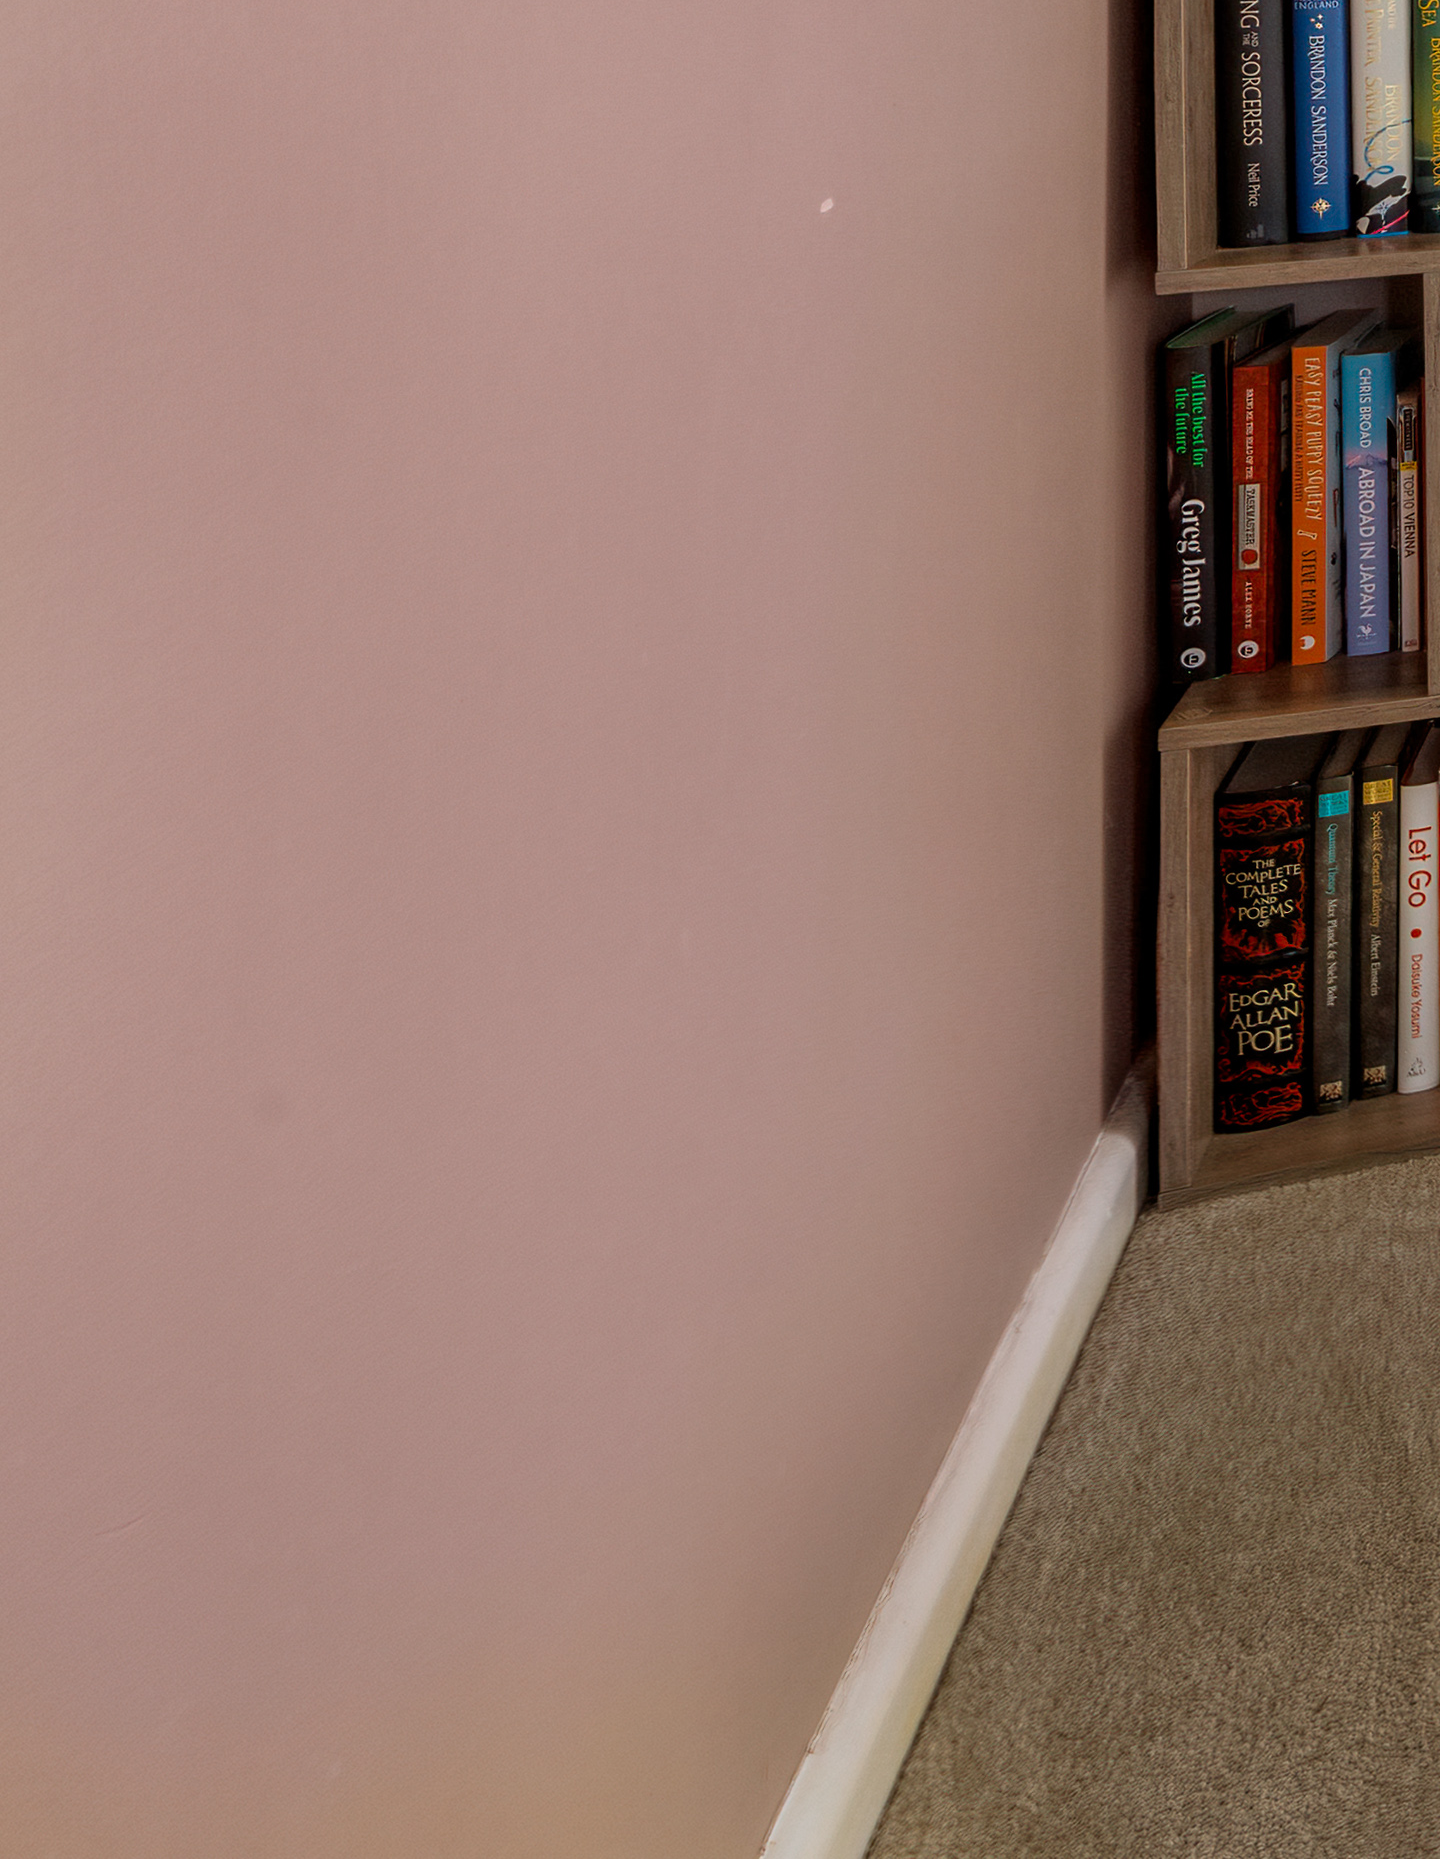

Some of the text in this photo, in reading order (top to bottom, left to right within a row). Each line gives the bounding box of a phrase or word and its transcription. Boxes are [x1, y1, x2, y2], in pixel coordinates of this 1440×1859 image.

[1308, 35, 1329, 186] BRANDON SANDERSON
[1247, 162, 1260, 207] Neil Price
[1174, 387, 1191, 454] the future
[1359, 367, 1372, 449] CHRIS BROAD
[1304, 357, 1325, 521] EASY PEASY PUPPY SQUEEZY
[1244, 487, 1256, 545] TASKMASTER
[1176, 498, 1206, 627] Greg James
[1357, 466, 1377, 618] ABROAD IN JAPAN
[1300, 549, 1318, 626] STEVE MANN
[1252, 858, 1276, 870] THE
[1326, 823, 1339, 863] Quantum
[1407, 826, 1432, 909] Let Go
[1225, 863, 1301, 885] COMPLETE
[1237, 879, 1289, 899] TALES
[1325, 865, 1339, 896] Theory
[1238, 899, 1295, 922] POEMS
[1252, 896, 1278, 906] AND
[1370, 934, 1382, 997] Albert Einstein
[1229, 982, 1302, 1013] EDGAR
[1229, 1000, 1299, 1030] ALLAN
[1410, 953, 1423, 1039] Daisuke Yosumi
[1237, 1024, 1294, 1056] POE
